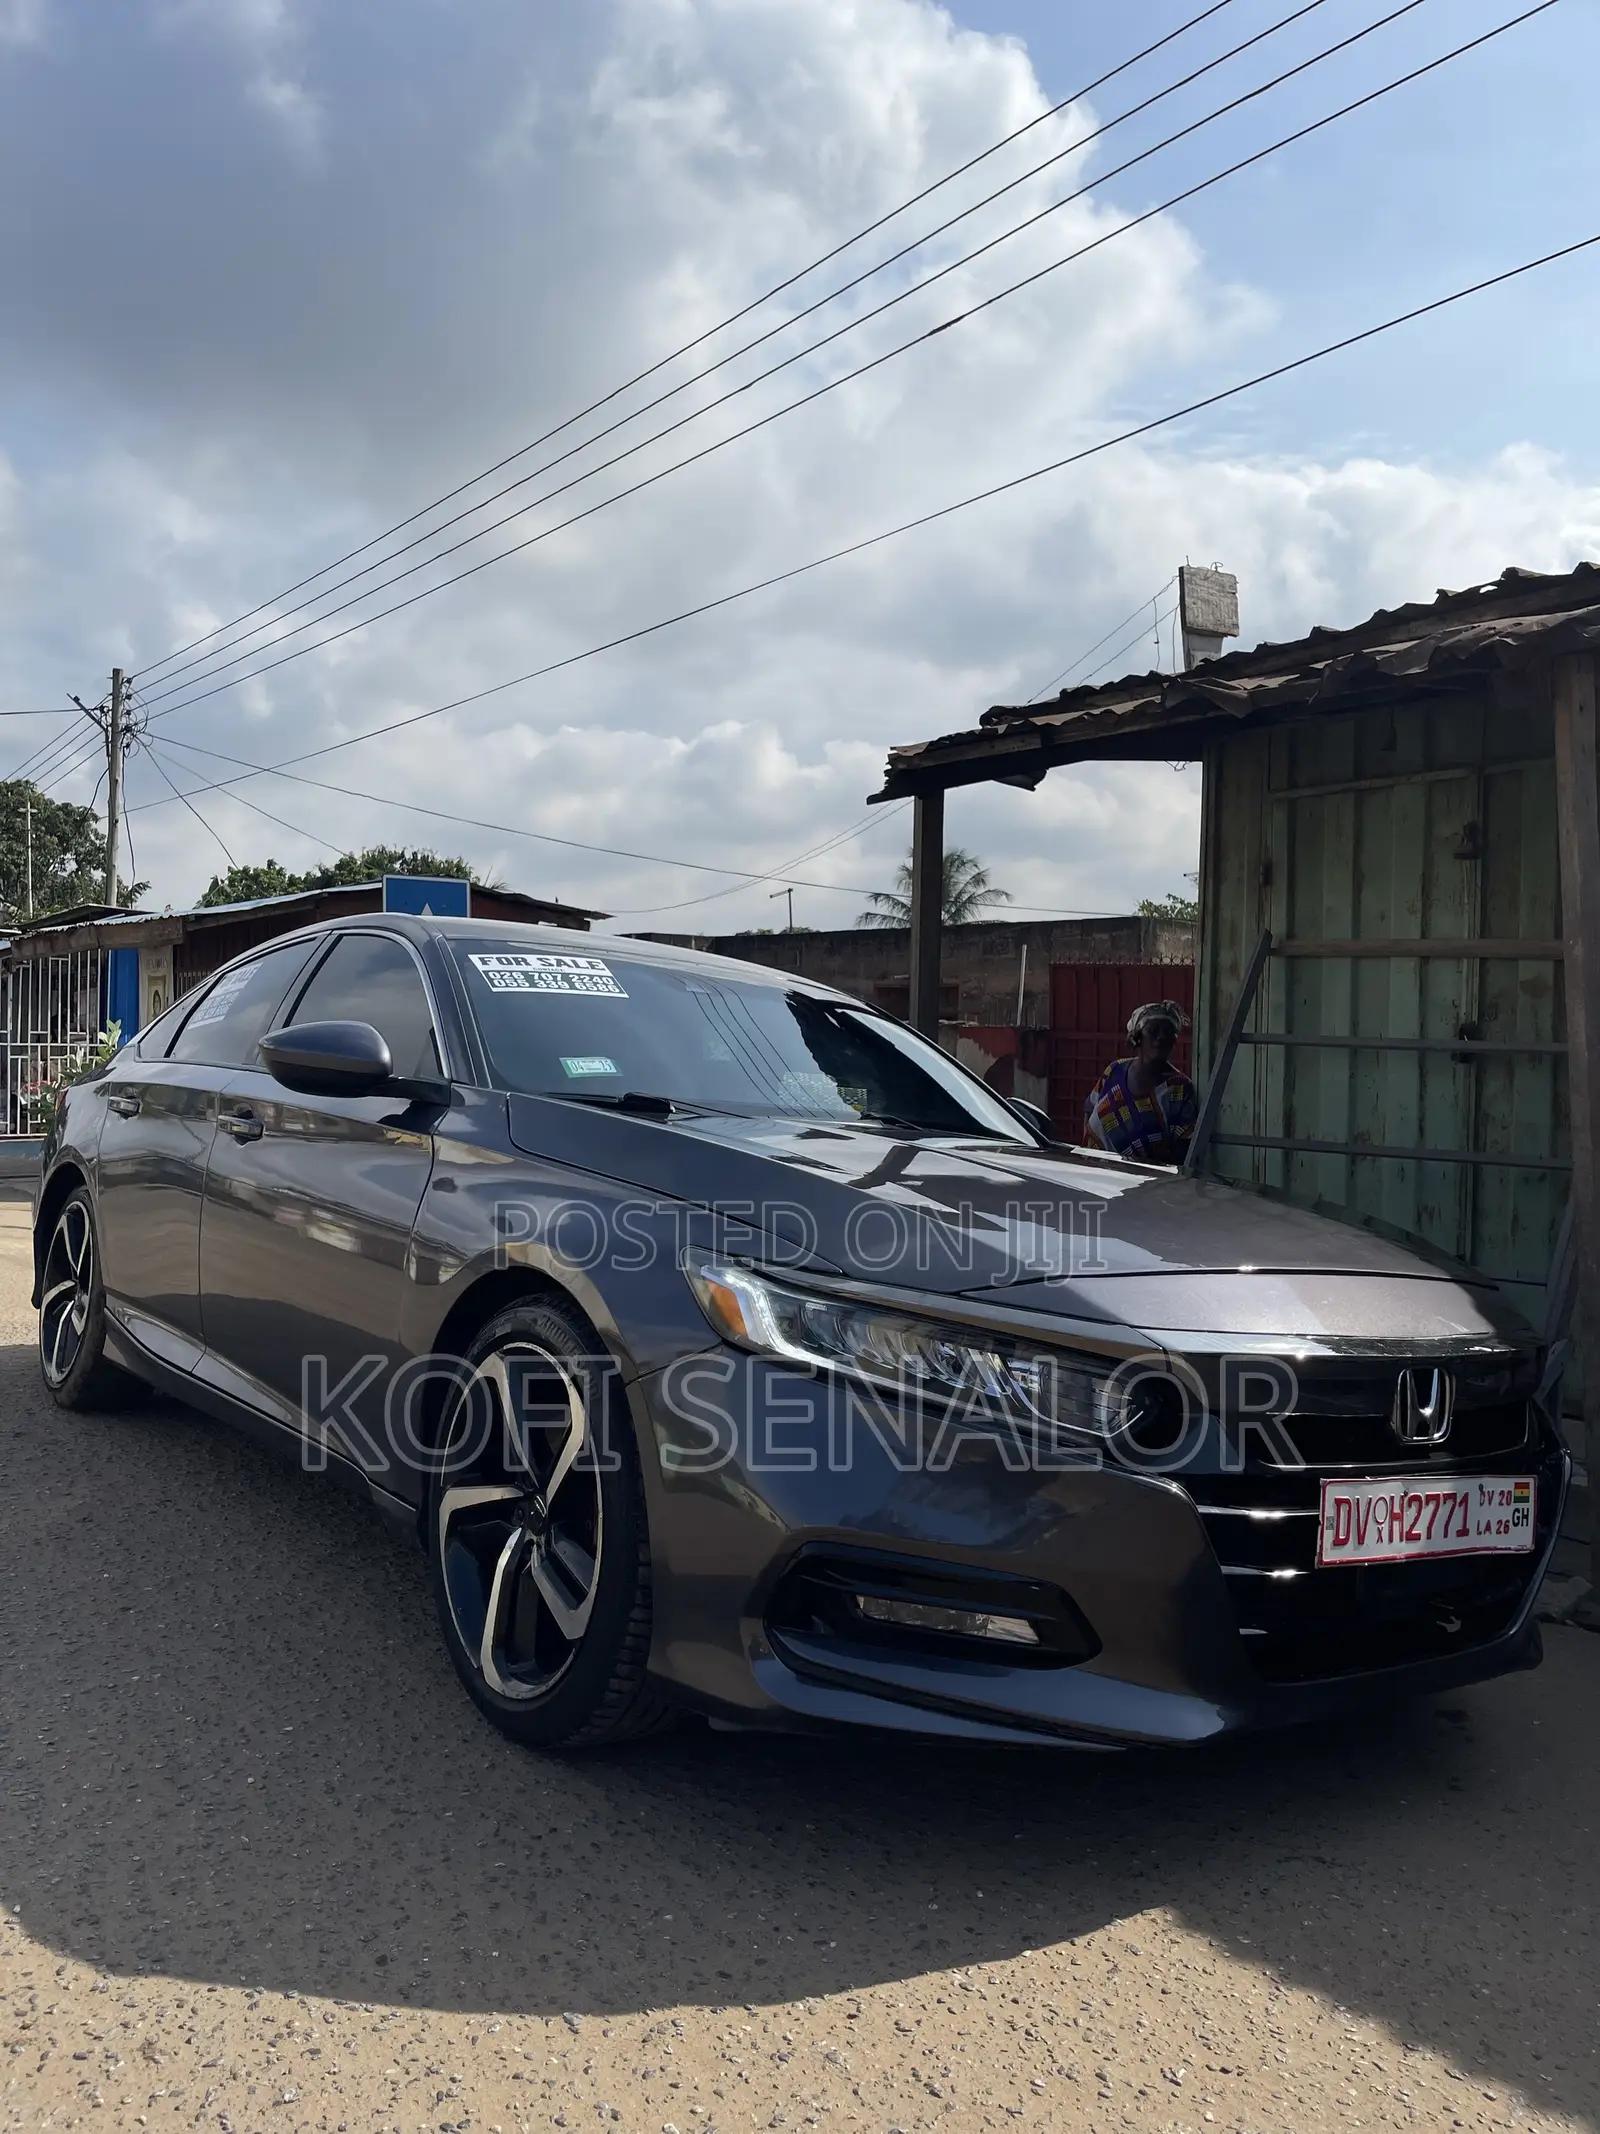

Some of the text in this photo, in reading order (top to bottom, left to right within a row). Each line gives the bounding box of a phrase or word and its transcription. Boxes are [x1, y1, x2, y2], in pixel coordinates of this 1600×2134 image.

[478, 956, 606, 972] FOR SALE
[488, 971, 614, 985] 026 707 2240
[493, 979, 620, 993] 055 339 6586
[1511, 1507, 1530, 1528] GH
[1476, 1519, 1511, 1536] LA 26
